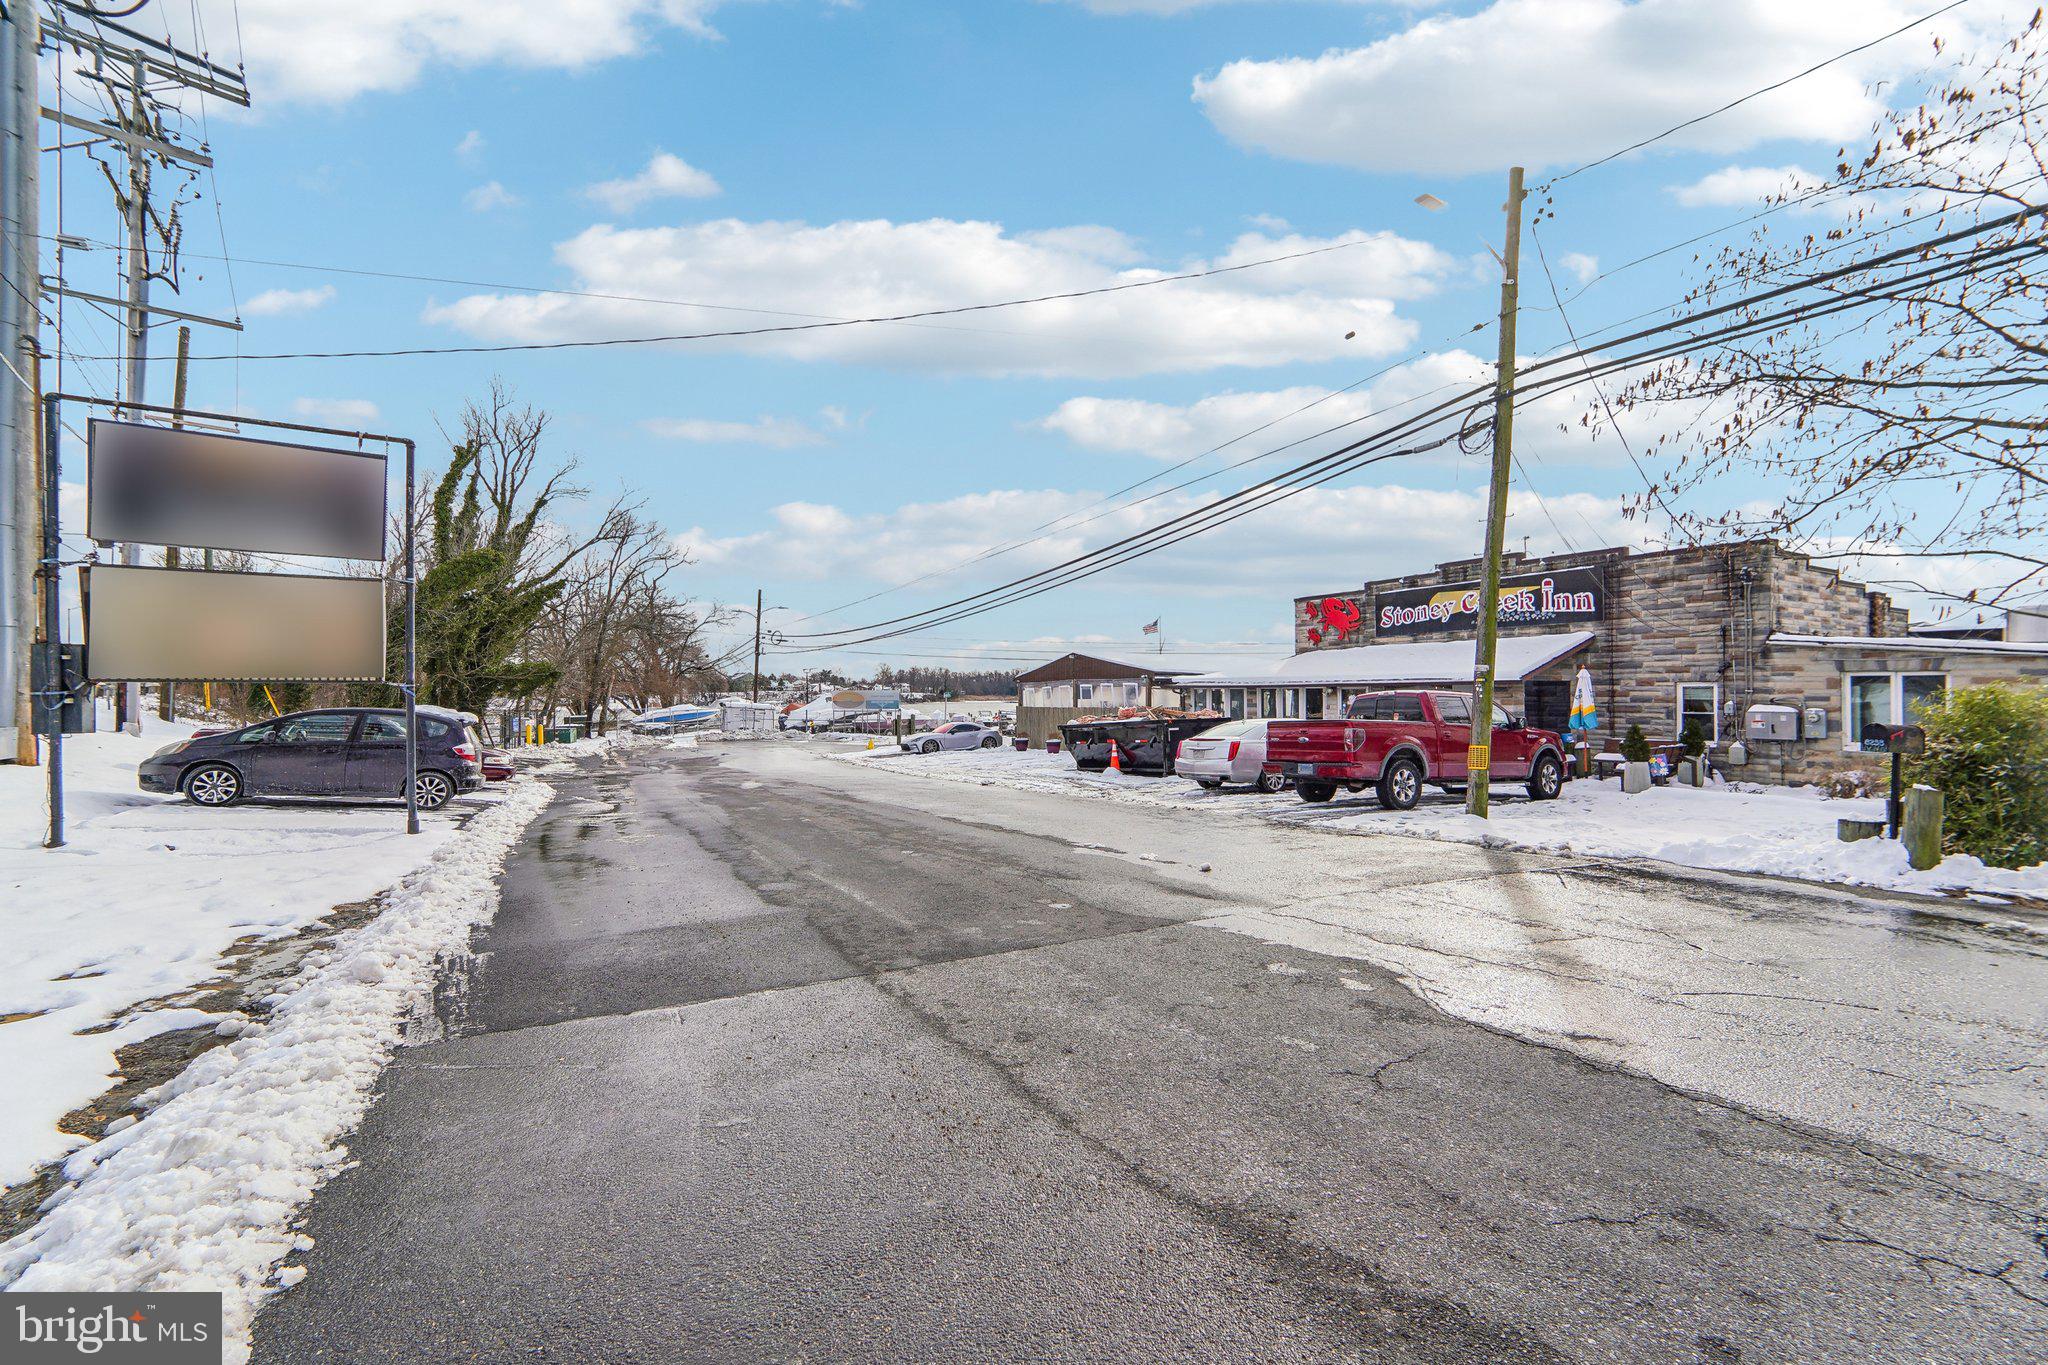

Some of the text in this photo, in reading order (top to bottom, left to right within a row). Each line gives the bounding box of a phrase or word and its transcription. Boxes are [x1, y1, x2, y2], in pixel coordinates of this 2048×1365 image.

[1380, 578, 1596, 628] Stoney Cek Inn
